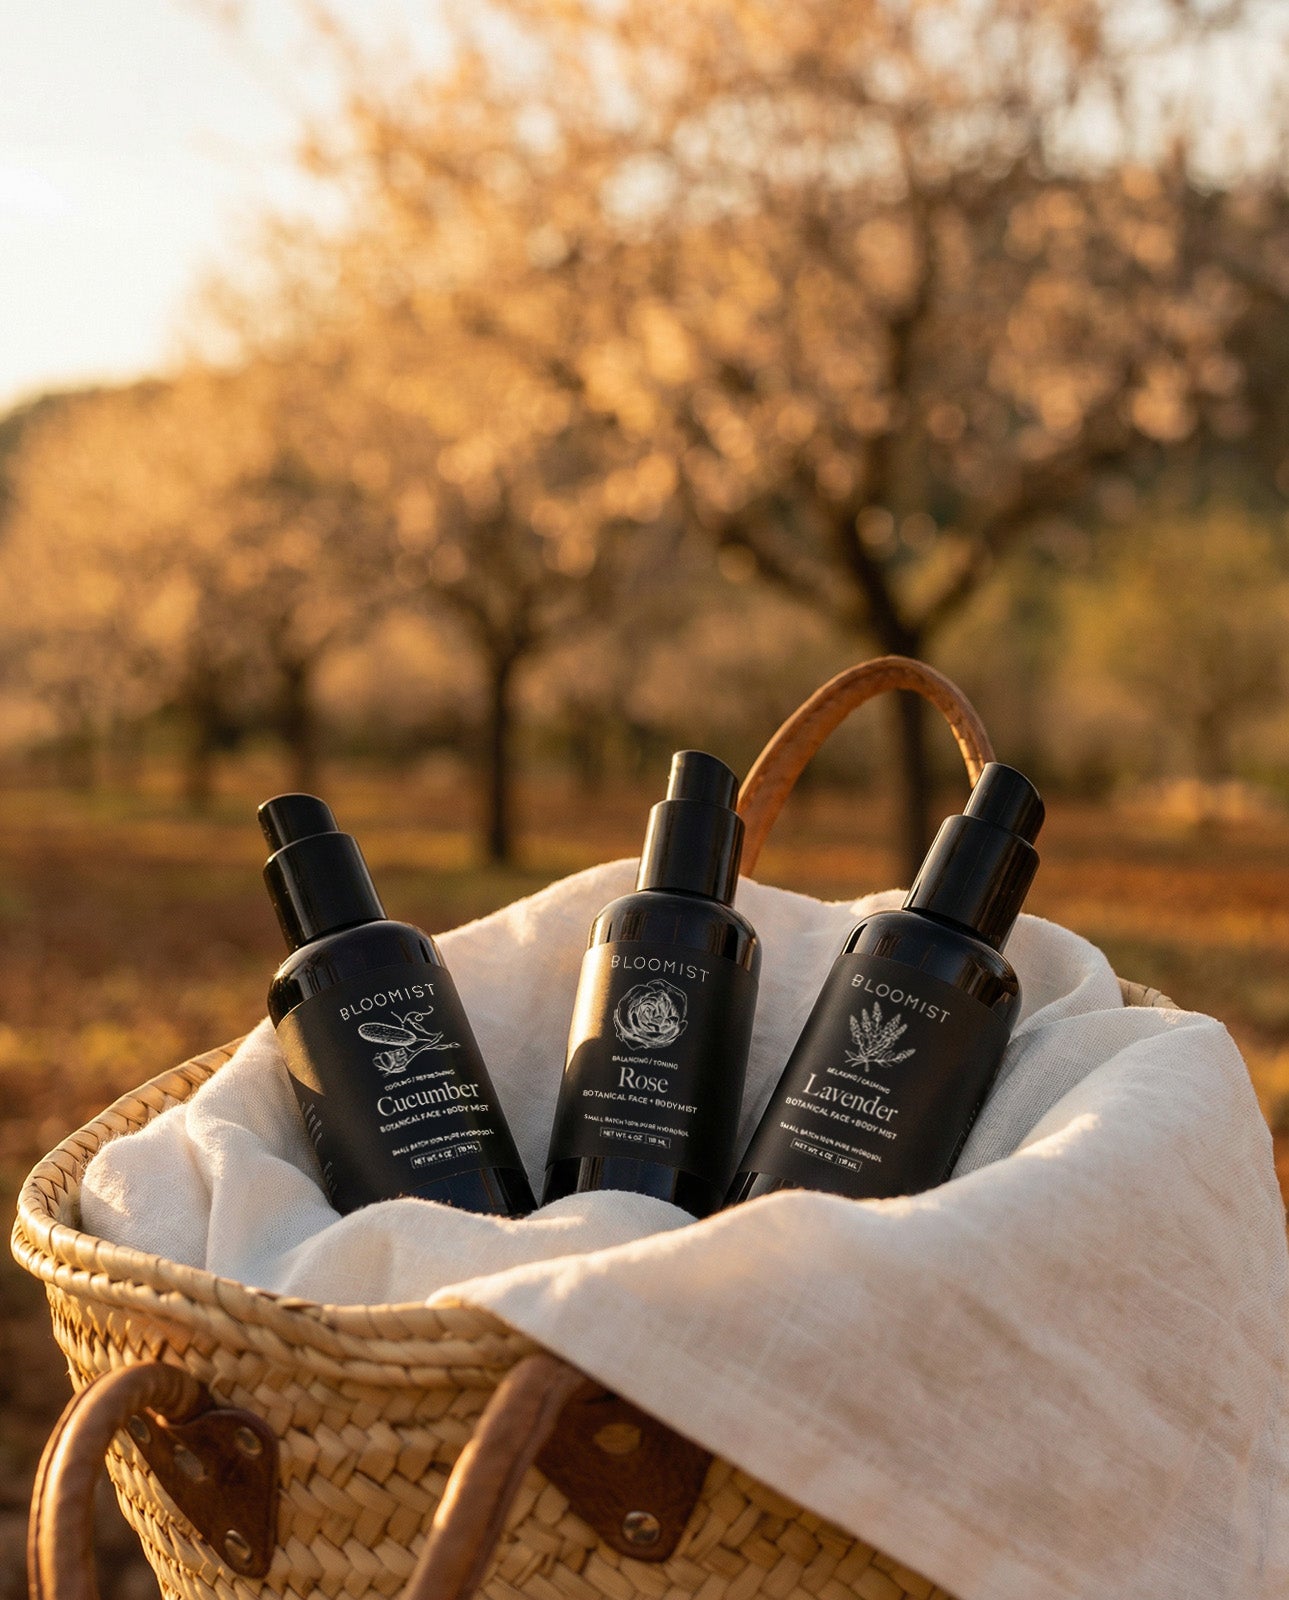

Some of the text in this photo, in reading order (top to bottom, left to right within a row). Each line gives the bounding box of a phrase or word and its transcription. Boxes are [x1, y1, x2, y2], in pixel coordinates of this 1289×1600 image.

[611, 954, 710, 982] BLOOMIST
[339, 983, 435, 1021] BLOOMIST
[851, 973, 951, 1023] BLOOMIST
[611, 1055, 649, 1064] BALANCING
[653, 1060, 679, 1070] TONING
[618, 1066, 669, 1093] Rose
[861, 1079, 891, 1094] CALMING
[377, 1081, 480, 1117] Cucumber
[582, 1089, 626, 1101] BOTANICAL
[628, 1094, 648, 1105] FACE
[655, 1098, 678, 1110] BODY
[677, 1104, 698, 1114] MIST
[803, 1073, 899, 1122] Lavender
[380, 1114, 421, 1133] BOTANICAL
[421, 1109, 442, 1120] FACE
[446, 1105, 469, 1115] BODY
[470, 1104, 489, 1112] MIST
[583, 1113, 603, 1123] SMALL
[780, 1121, 799, 1134] SMALL
[785, 1096, 828, 1116] BOTANICAL
[830, 1111, 851, 1124] FACE
[855, 1120, 878, 1133] BODY
[878, 1127, 898, 1140] MIST
[793, 1141, 807, 1150] NET
